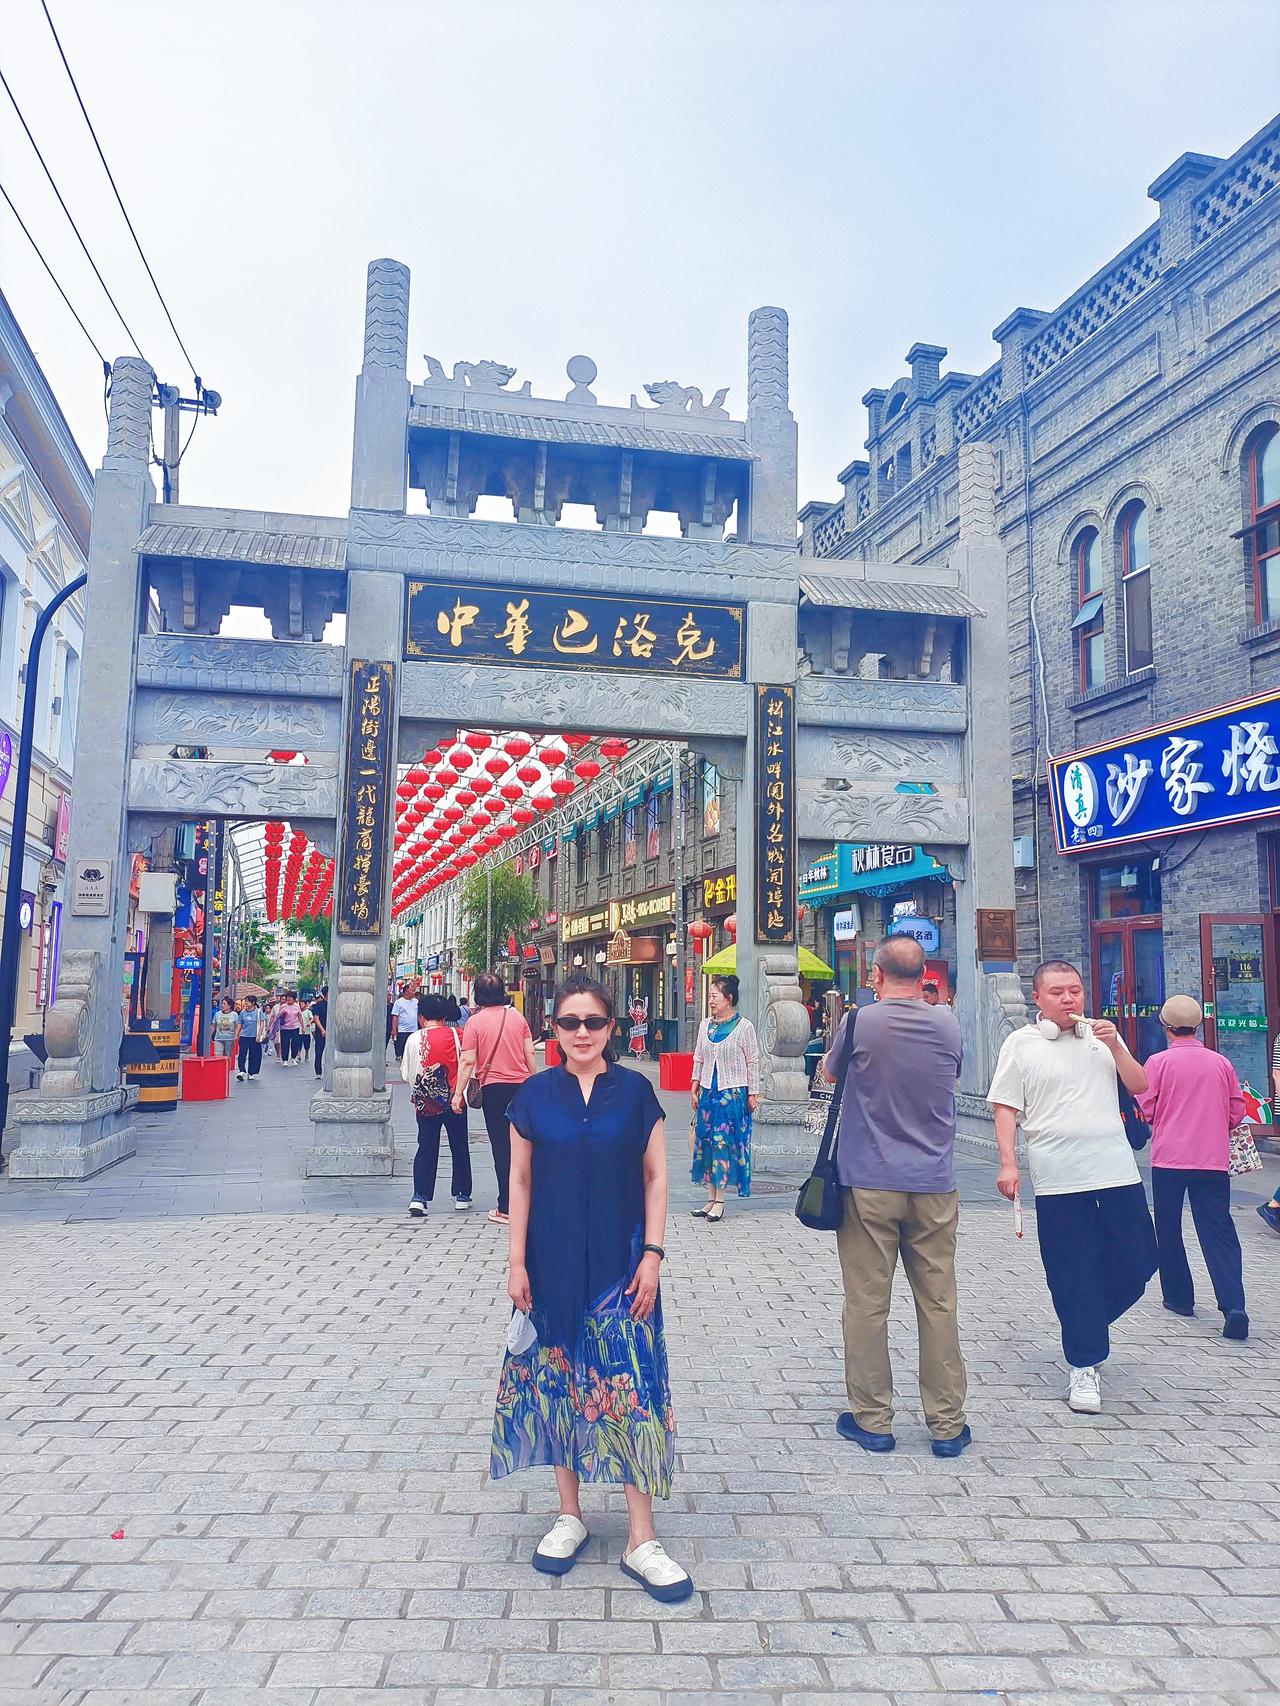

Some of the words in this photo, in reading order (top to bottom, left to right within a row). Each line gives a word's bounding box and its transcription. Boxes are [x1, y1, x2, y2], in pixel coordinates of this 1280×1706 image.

[437, 597, 715, 665] 中華巴洛克
[1071, 825, 1101, 844] 老四
[1217, 1018, 1258, 1028] 欢迎光临
